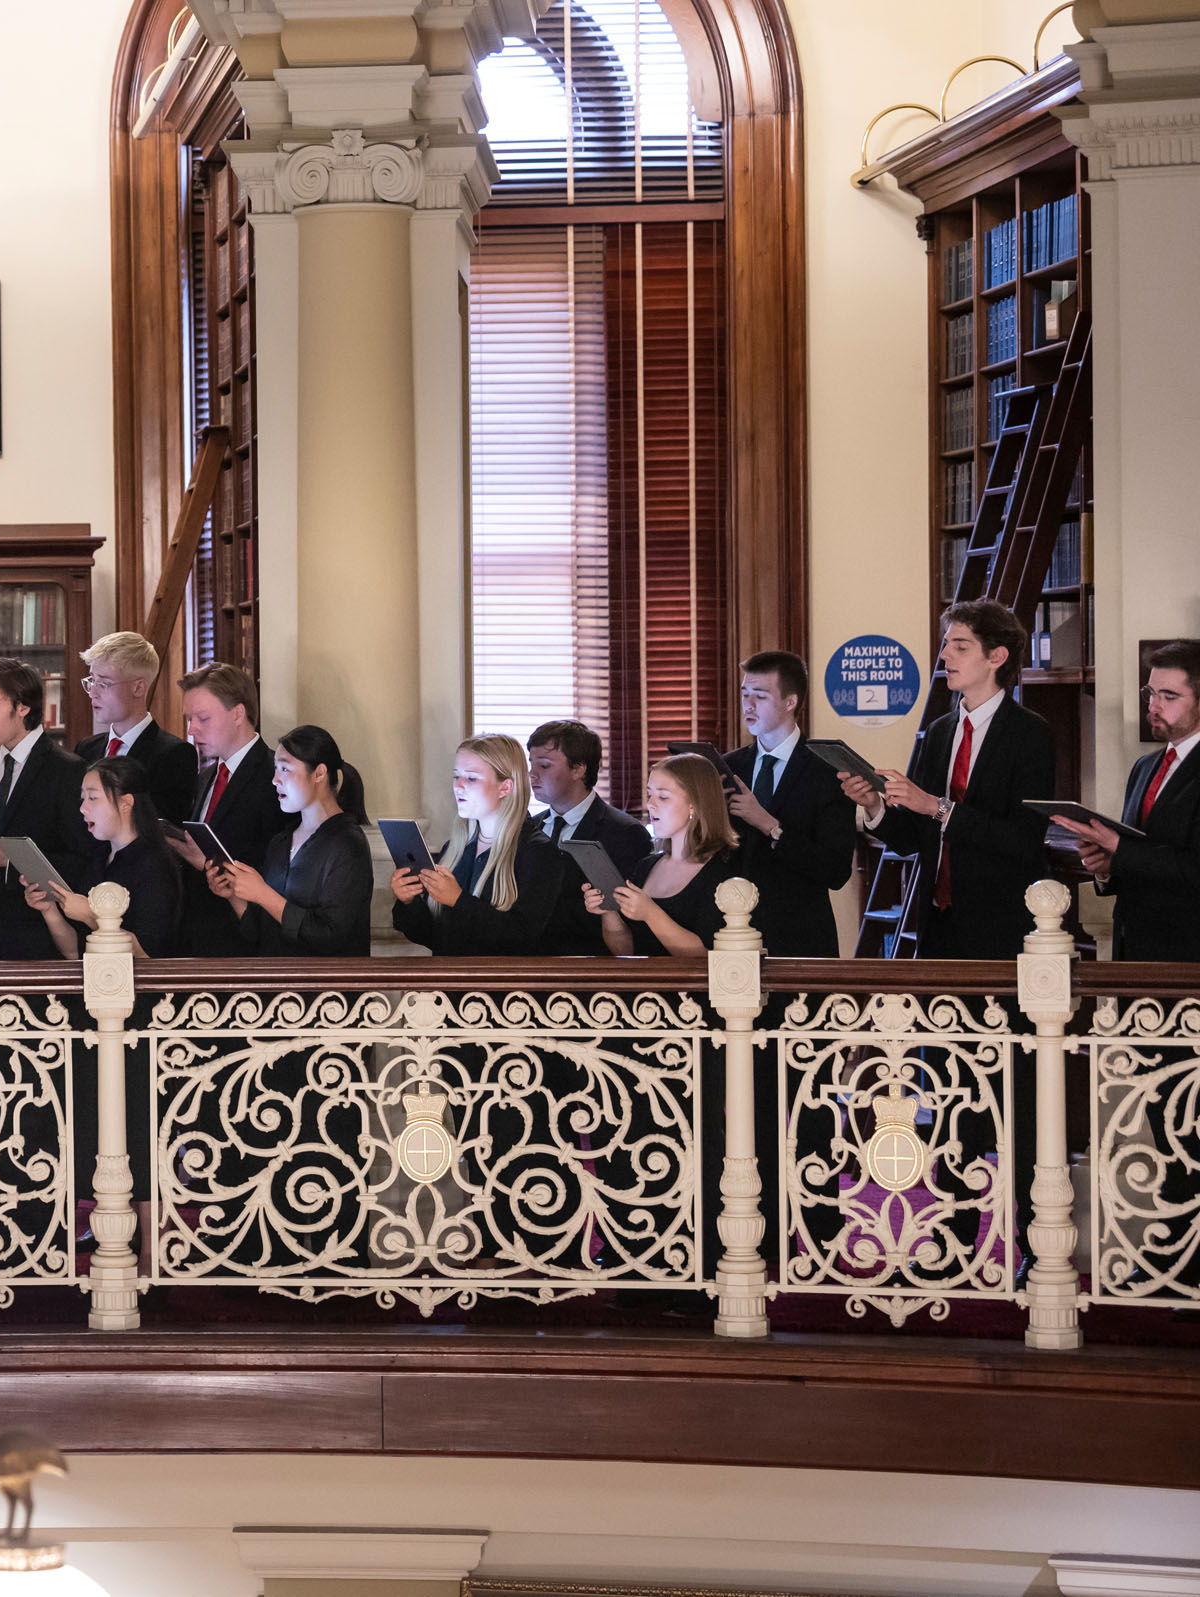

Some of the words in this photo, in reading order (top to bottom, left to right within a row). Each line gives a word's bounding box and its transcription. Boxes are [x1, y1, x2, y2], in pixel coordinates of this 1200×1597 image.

[844, 646, 899, 657] MAXIMUM
[841, 658, 885, 669] PEOPLE
[888, 658, 903, 668] TO
[841, 671, 867, 681] THIS
[870, 670, 903, 681] ROOM
[865, 689, 878, 703] 2
